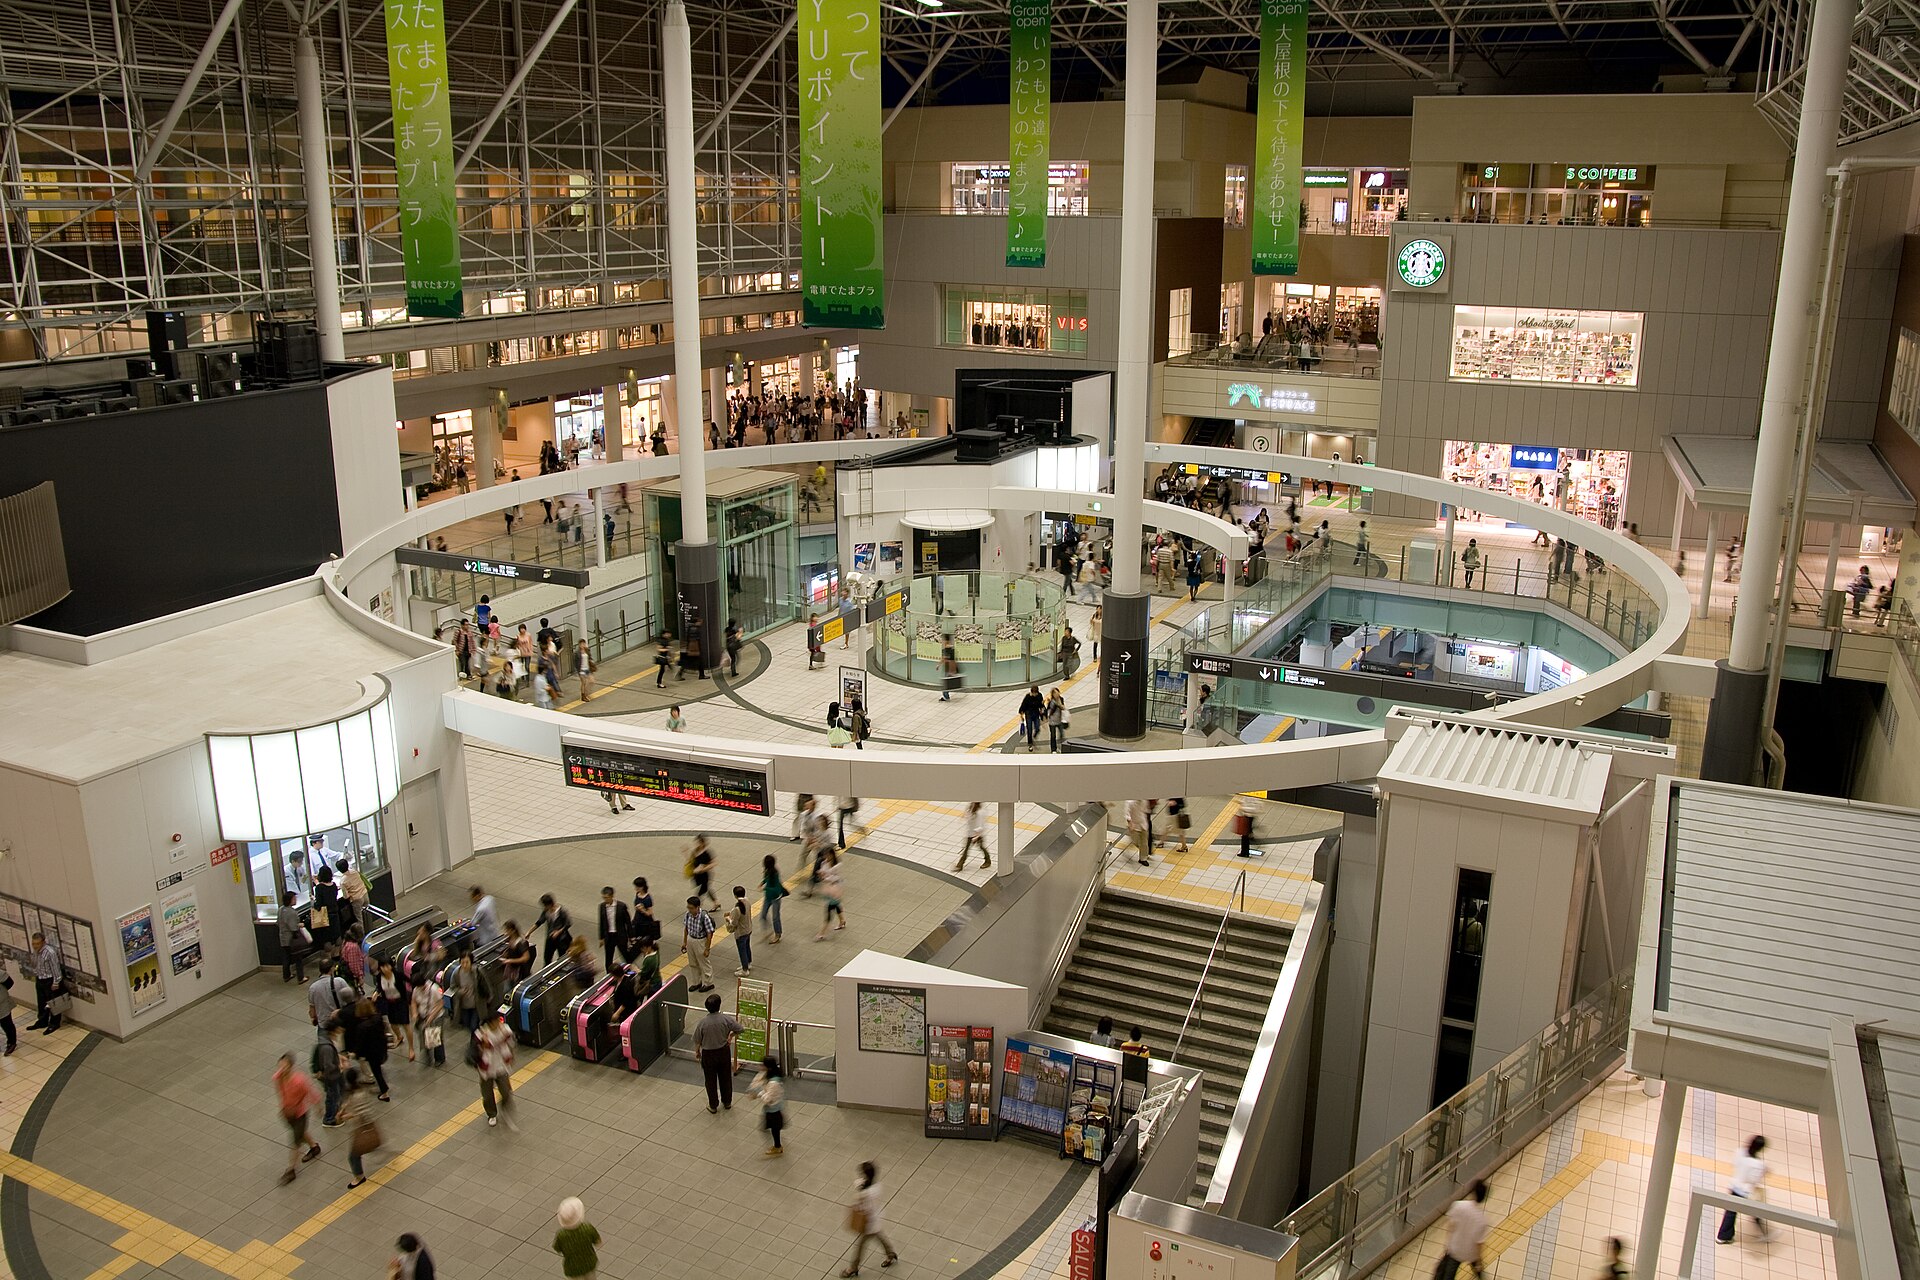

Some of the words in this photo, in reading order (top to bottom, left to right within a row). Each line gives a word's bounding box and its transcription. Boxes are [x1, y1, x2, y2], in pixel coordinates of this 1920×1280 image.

[1012, 4, 1049, 17] Grand
[1267, 4, 1302, 17] open
[1016, 17, 1046, 29] open
[842, 12, 869, 81] って
[1031, 36, 1046, 157] いつもと違う
[1577, 167, 1638, 181] COFFEE
[1401, 241, 1443, 263] STARBUCKS
[410, 280, 456, 289] 電車でたまプラ
[1404, 271, 1436, 285] COFFEE
[809, 285, 875, 296] 電車でたまプラ
[1056, 316, 1088, 331] VIS
[1517, 316, 1547, 329] About
[1552, 318, 1576, 330] Girl
[1264, 397, 1316, 412] TERRACE
[1515, 450, 1553, 462] PLAZA
[471, 561, 478, 572] 2
[679, 601, 684, 612] 2
[1120, 662, 1126, 673] 1
[1272, 668, 1278, 681] 1
[576, 756, 582, 764] 2
[748, 780, 752, 790] 1
